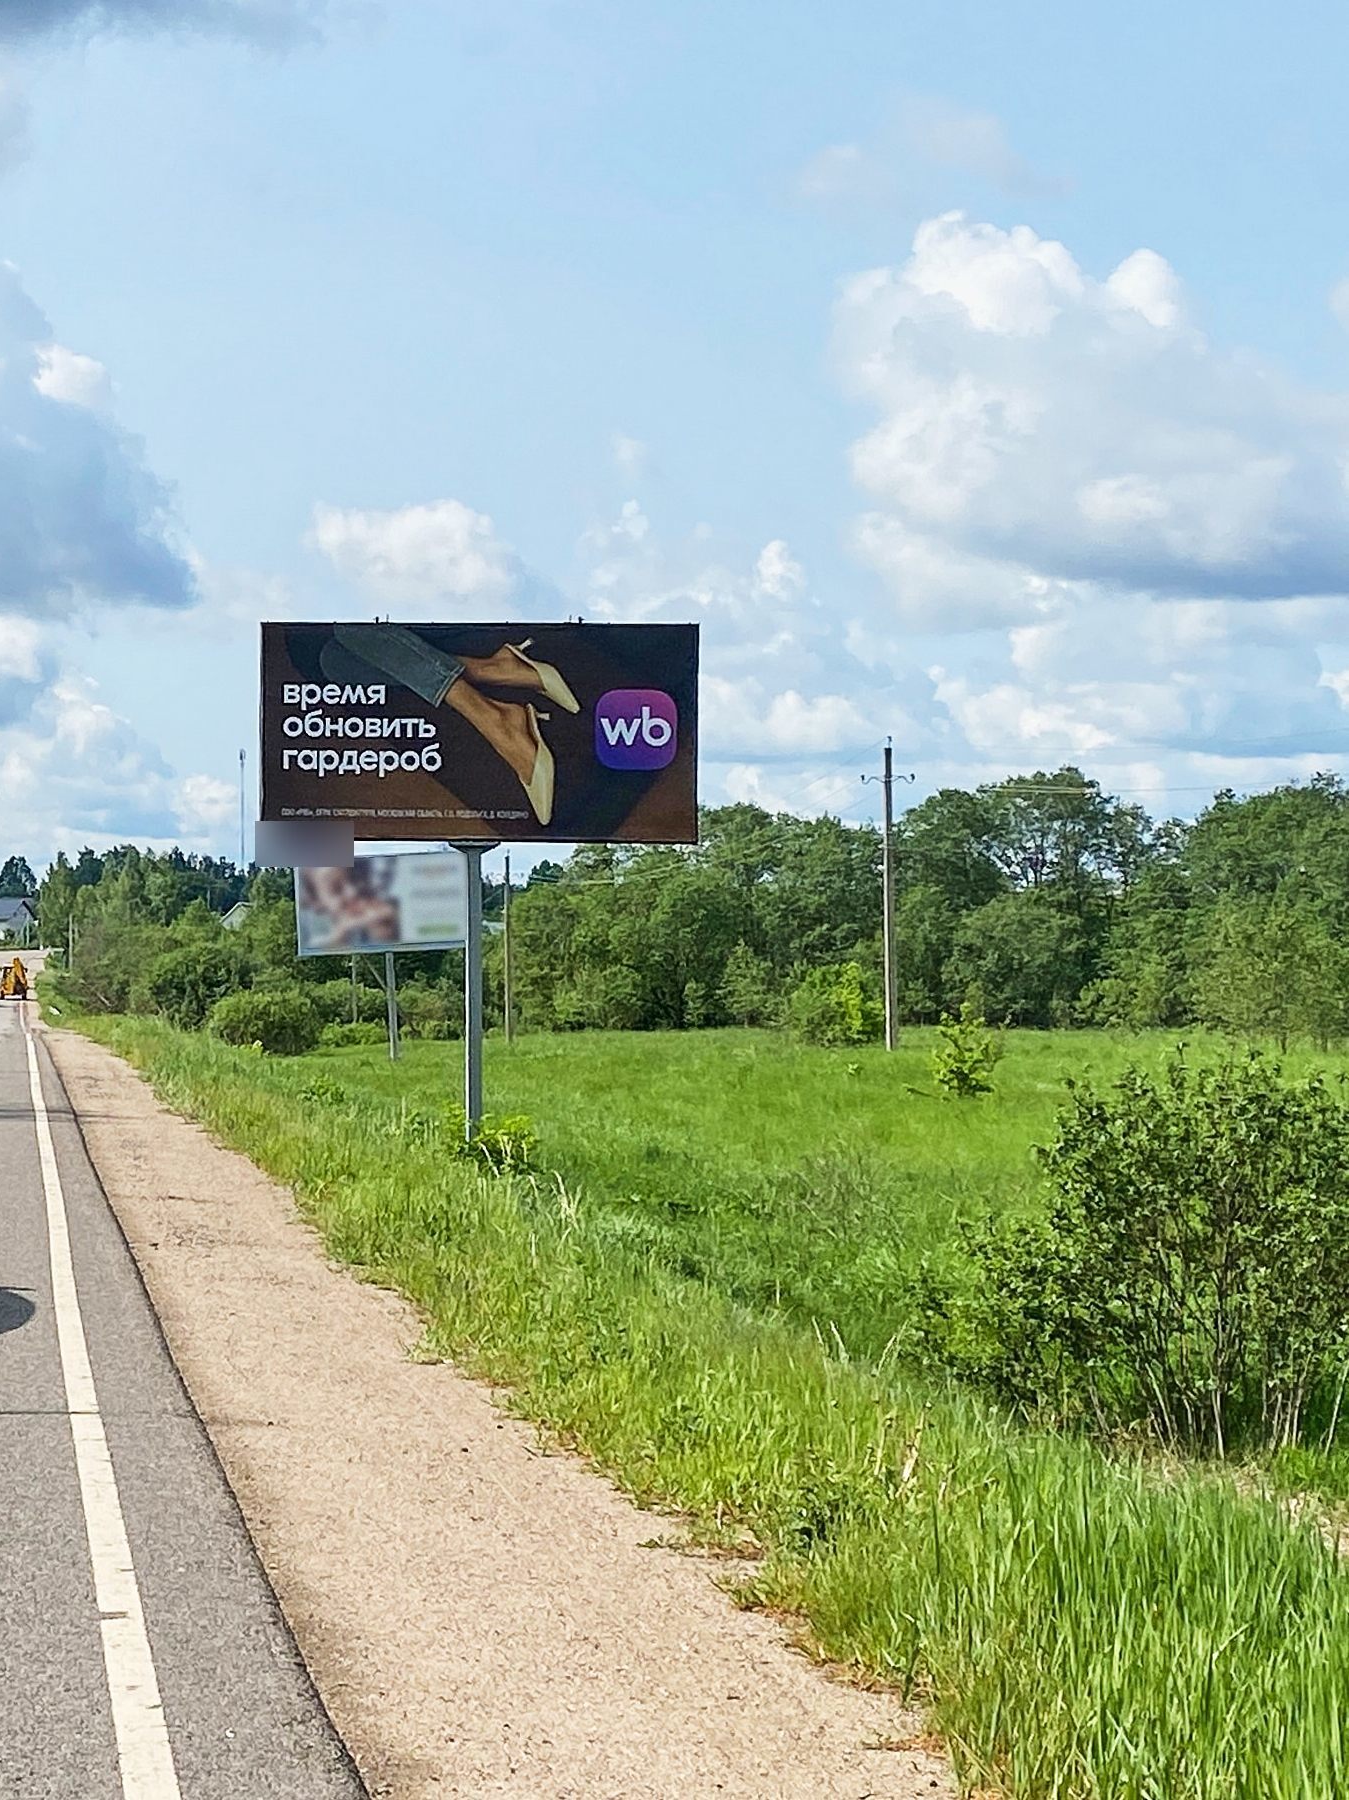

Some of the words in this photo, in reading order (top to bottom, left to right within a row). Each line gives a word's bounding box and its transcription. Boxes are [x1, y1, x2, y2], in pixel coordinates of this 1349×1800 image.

[283, 683, 386, 711] время
[282, 708, 437, 738] обновить
[600, 706, 672, 747] wb
[282, 743, 443, 778] гардероб
